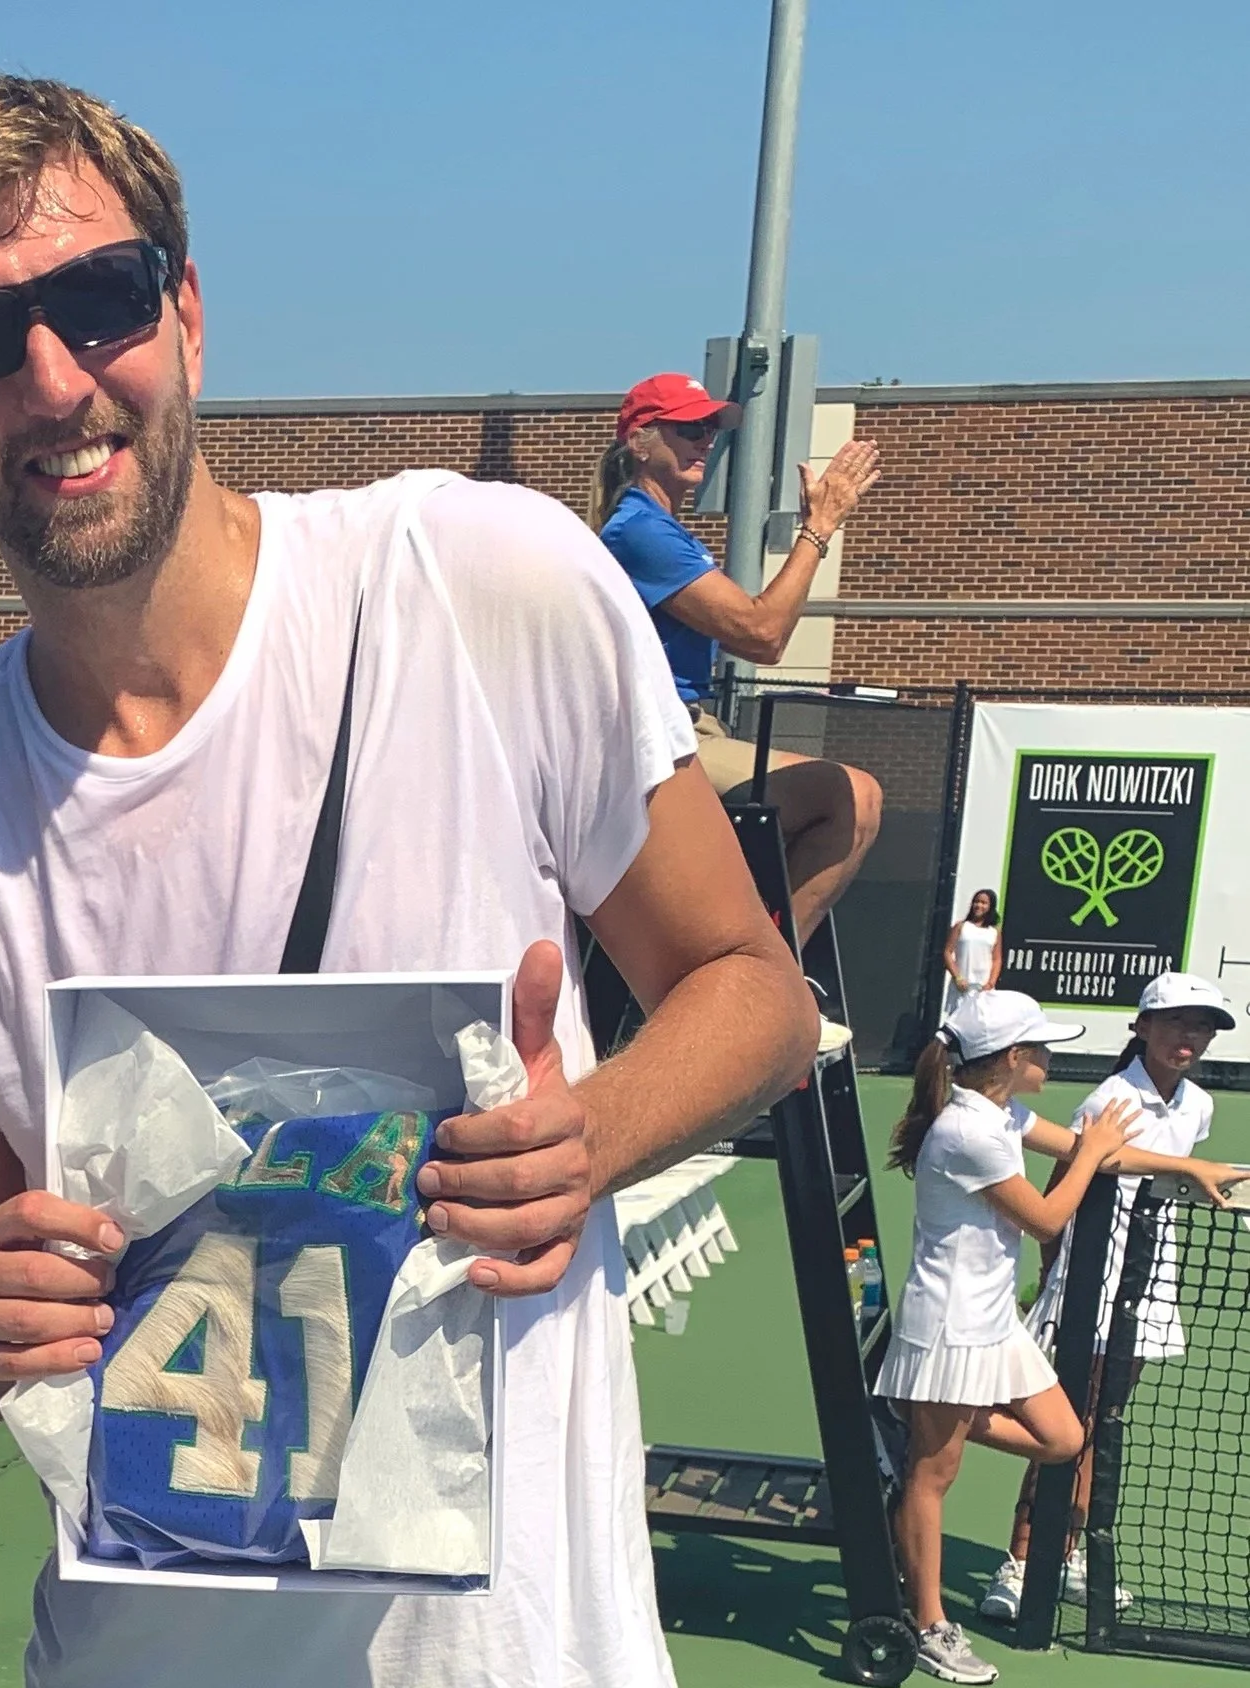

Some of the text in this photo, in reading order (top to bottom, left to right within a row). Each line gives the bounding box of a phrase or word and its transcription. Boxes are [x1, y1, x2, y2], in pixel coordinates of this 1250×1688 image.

[1028, 762, 1195, 805] DIRK NOWITZKI
[1006, 948, 1173, 976] PRO CELEBRITY TENNIS
[1056, 974, 1117, 998] CLASSIC
[100, 1231, 353, 1501] 41
